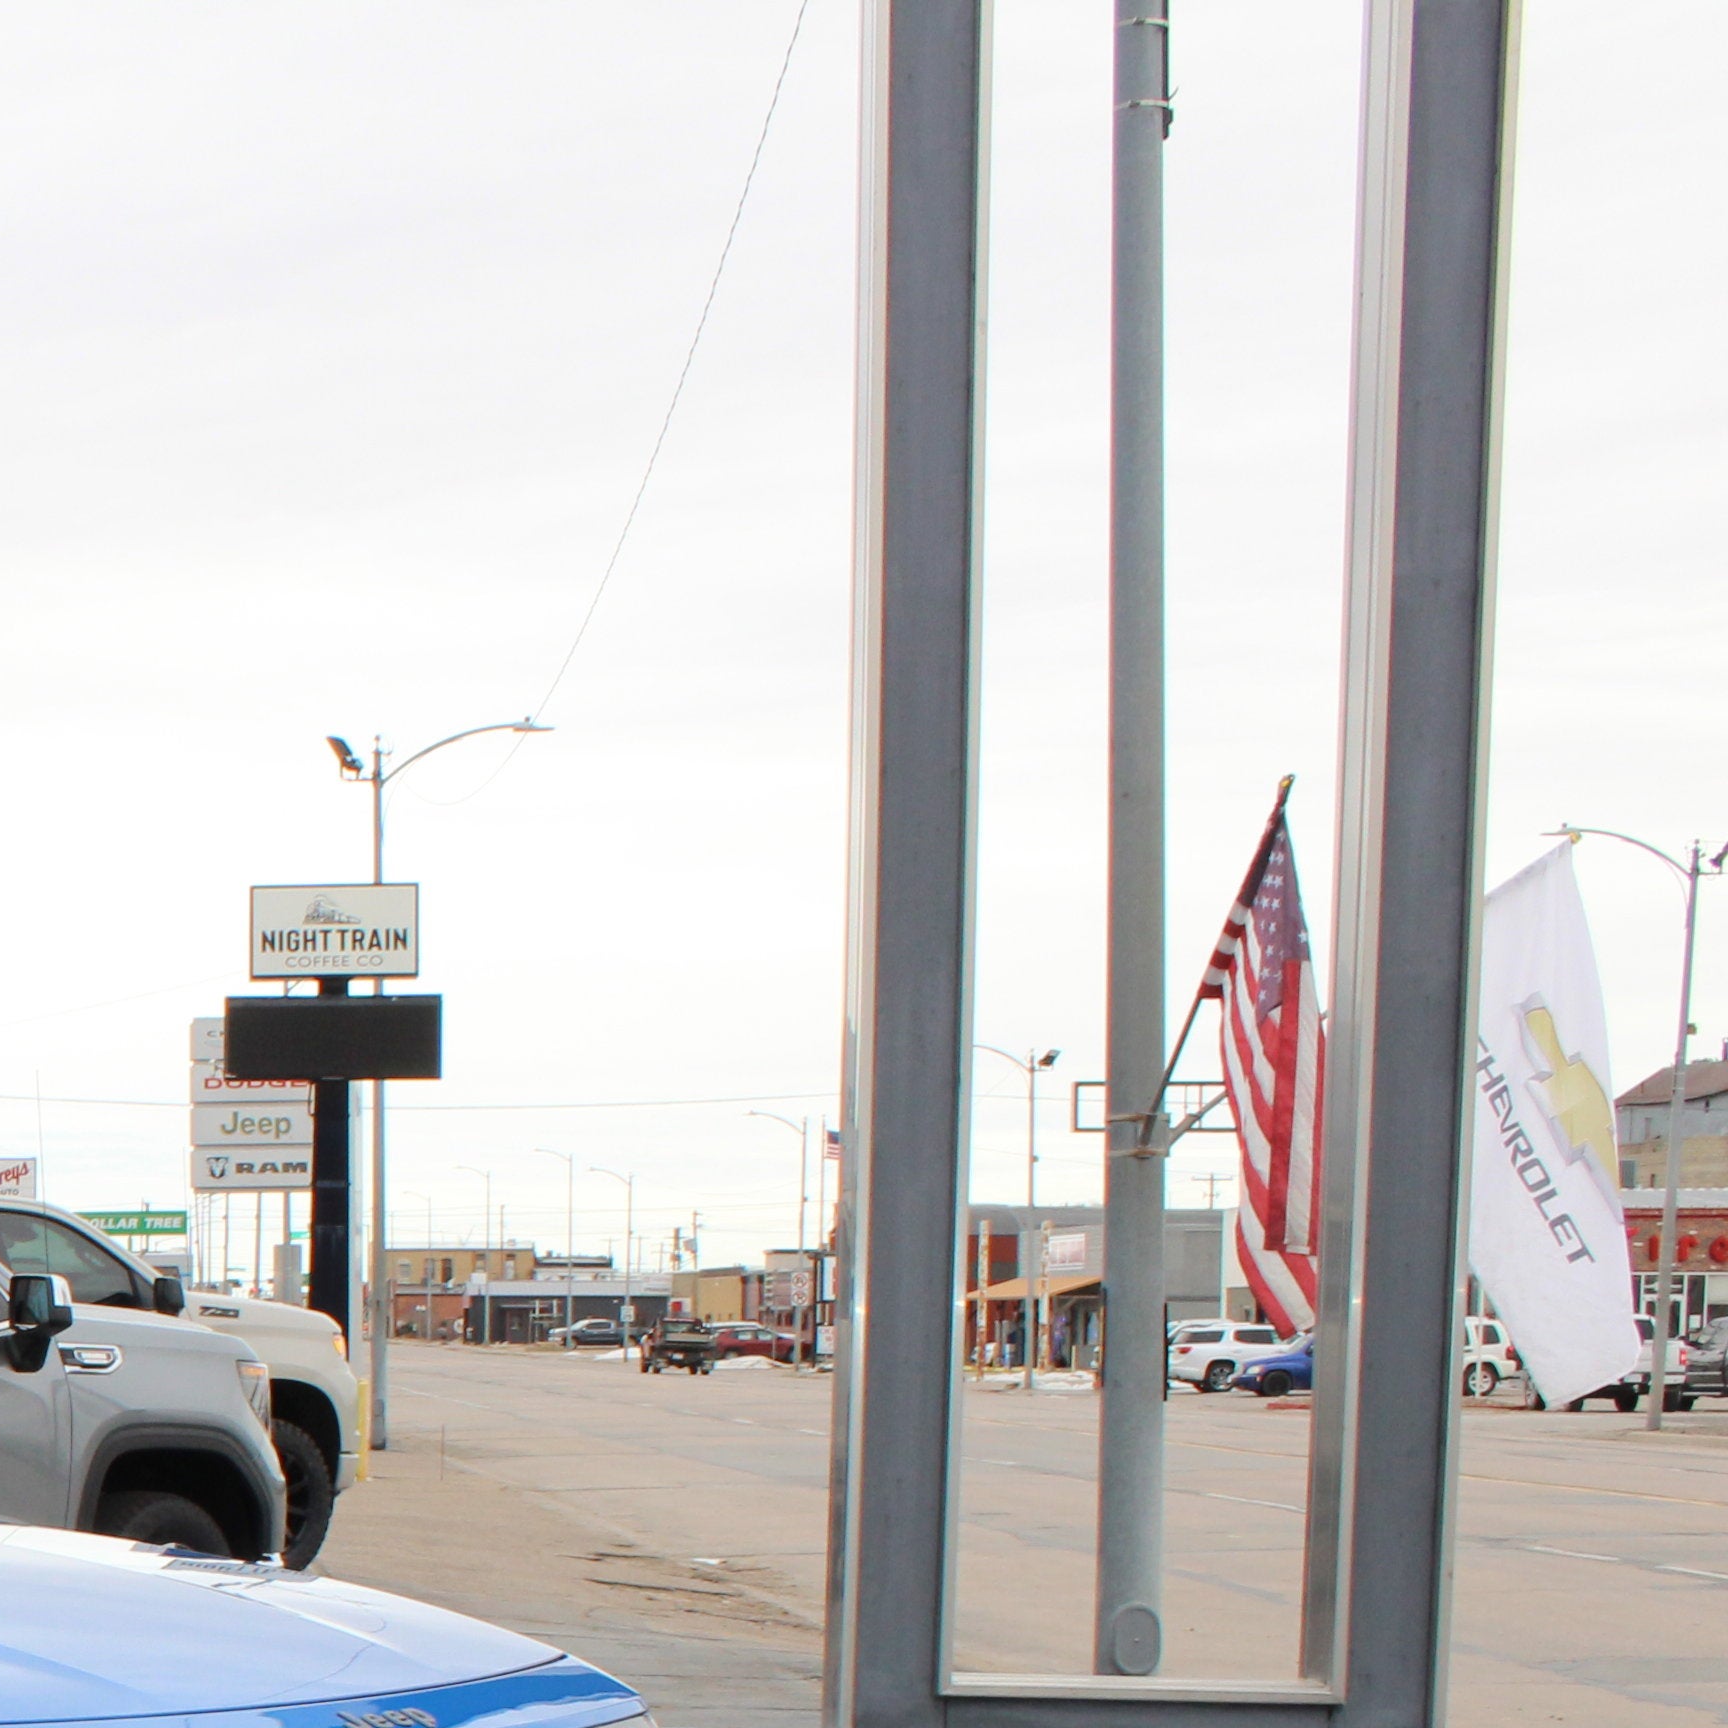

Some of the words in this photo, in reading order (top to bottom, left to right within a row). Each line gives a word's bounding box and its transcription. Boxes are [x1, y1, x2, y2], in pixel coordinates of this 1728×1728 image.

[261, 929, 334, 953] NIGHT
[336, 928, 408, 951] TRAIN
[285, 955, 350, 968] COFFEE
[357, 954, 384, 967] CO
[220, 1110, 292, 1139] Jeep
[1476, 1034, 1596, 1265] HEVROLET
[235, 1161, 309, 1175] RAM
[89, 1217, 139, 1230] OLLAR
[144, 1216, 183, 1229] TREE
